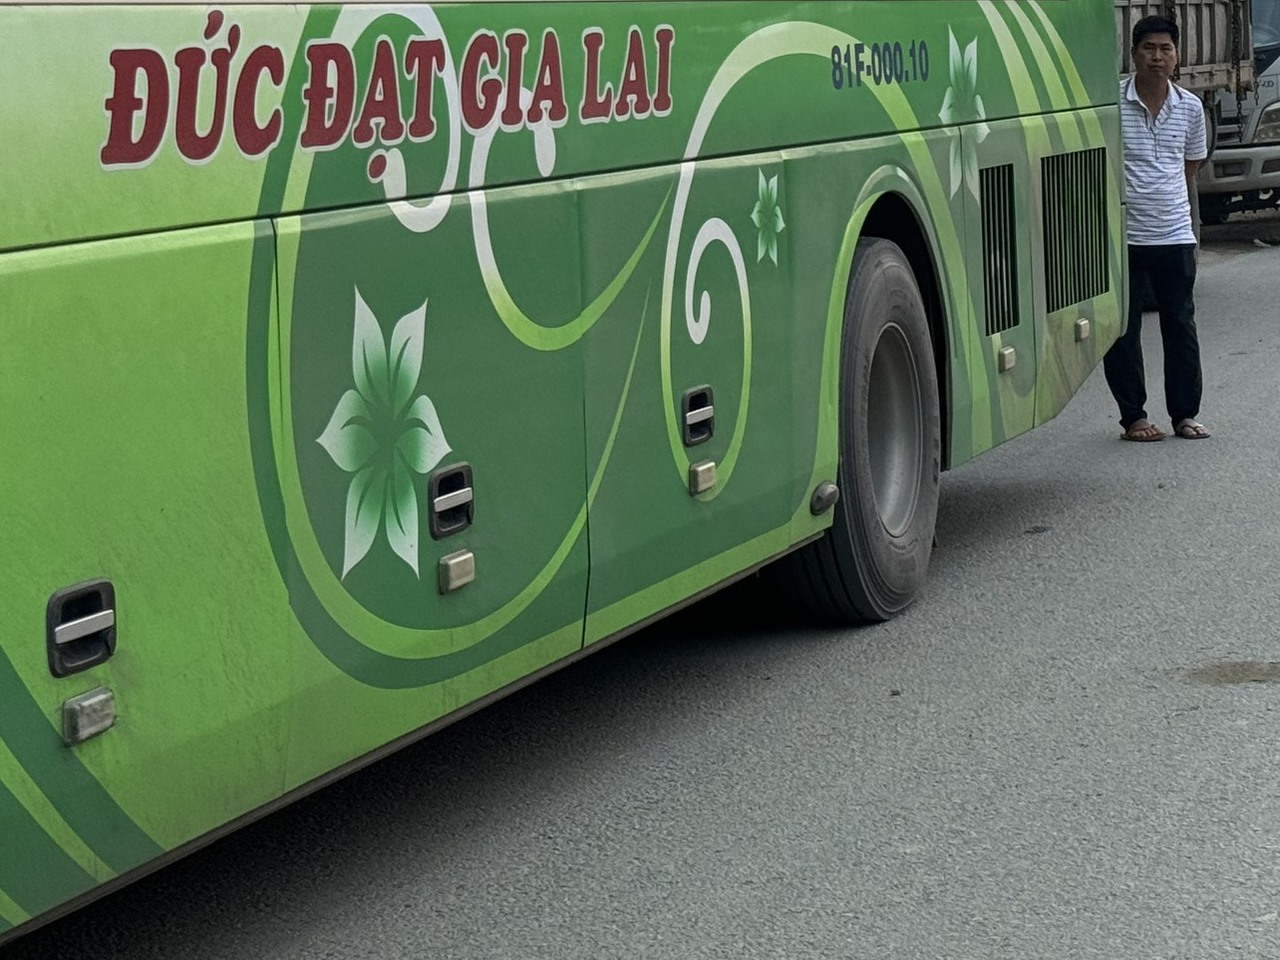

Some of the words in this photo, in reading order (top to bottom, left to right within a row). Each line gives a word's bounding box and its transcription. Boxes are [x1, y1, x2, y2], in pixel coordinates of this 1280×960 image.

[100, 9, 284, 170] ĐỨC
[300, 33, 447, 181] ĐẠT
[460, 27, 568, 133] GIA
[581, 23, 675, 125] LAI
[831, 39, 929, 91] 81F-000.10
